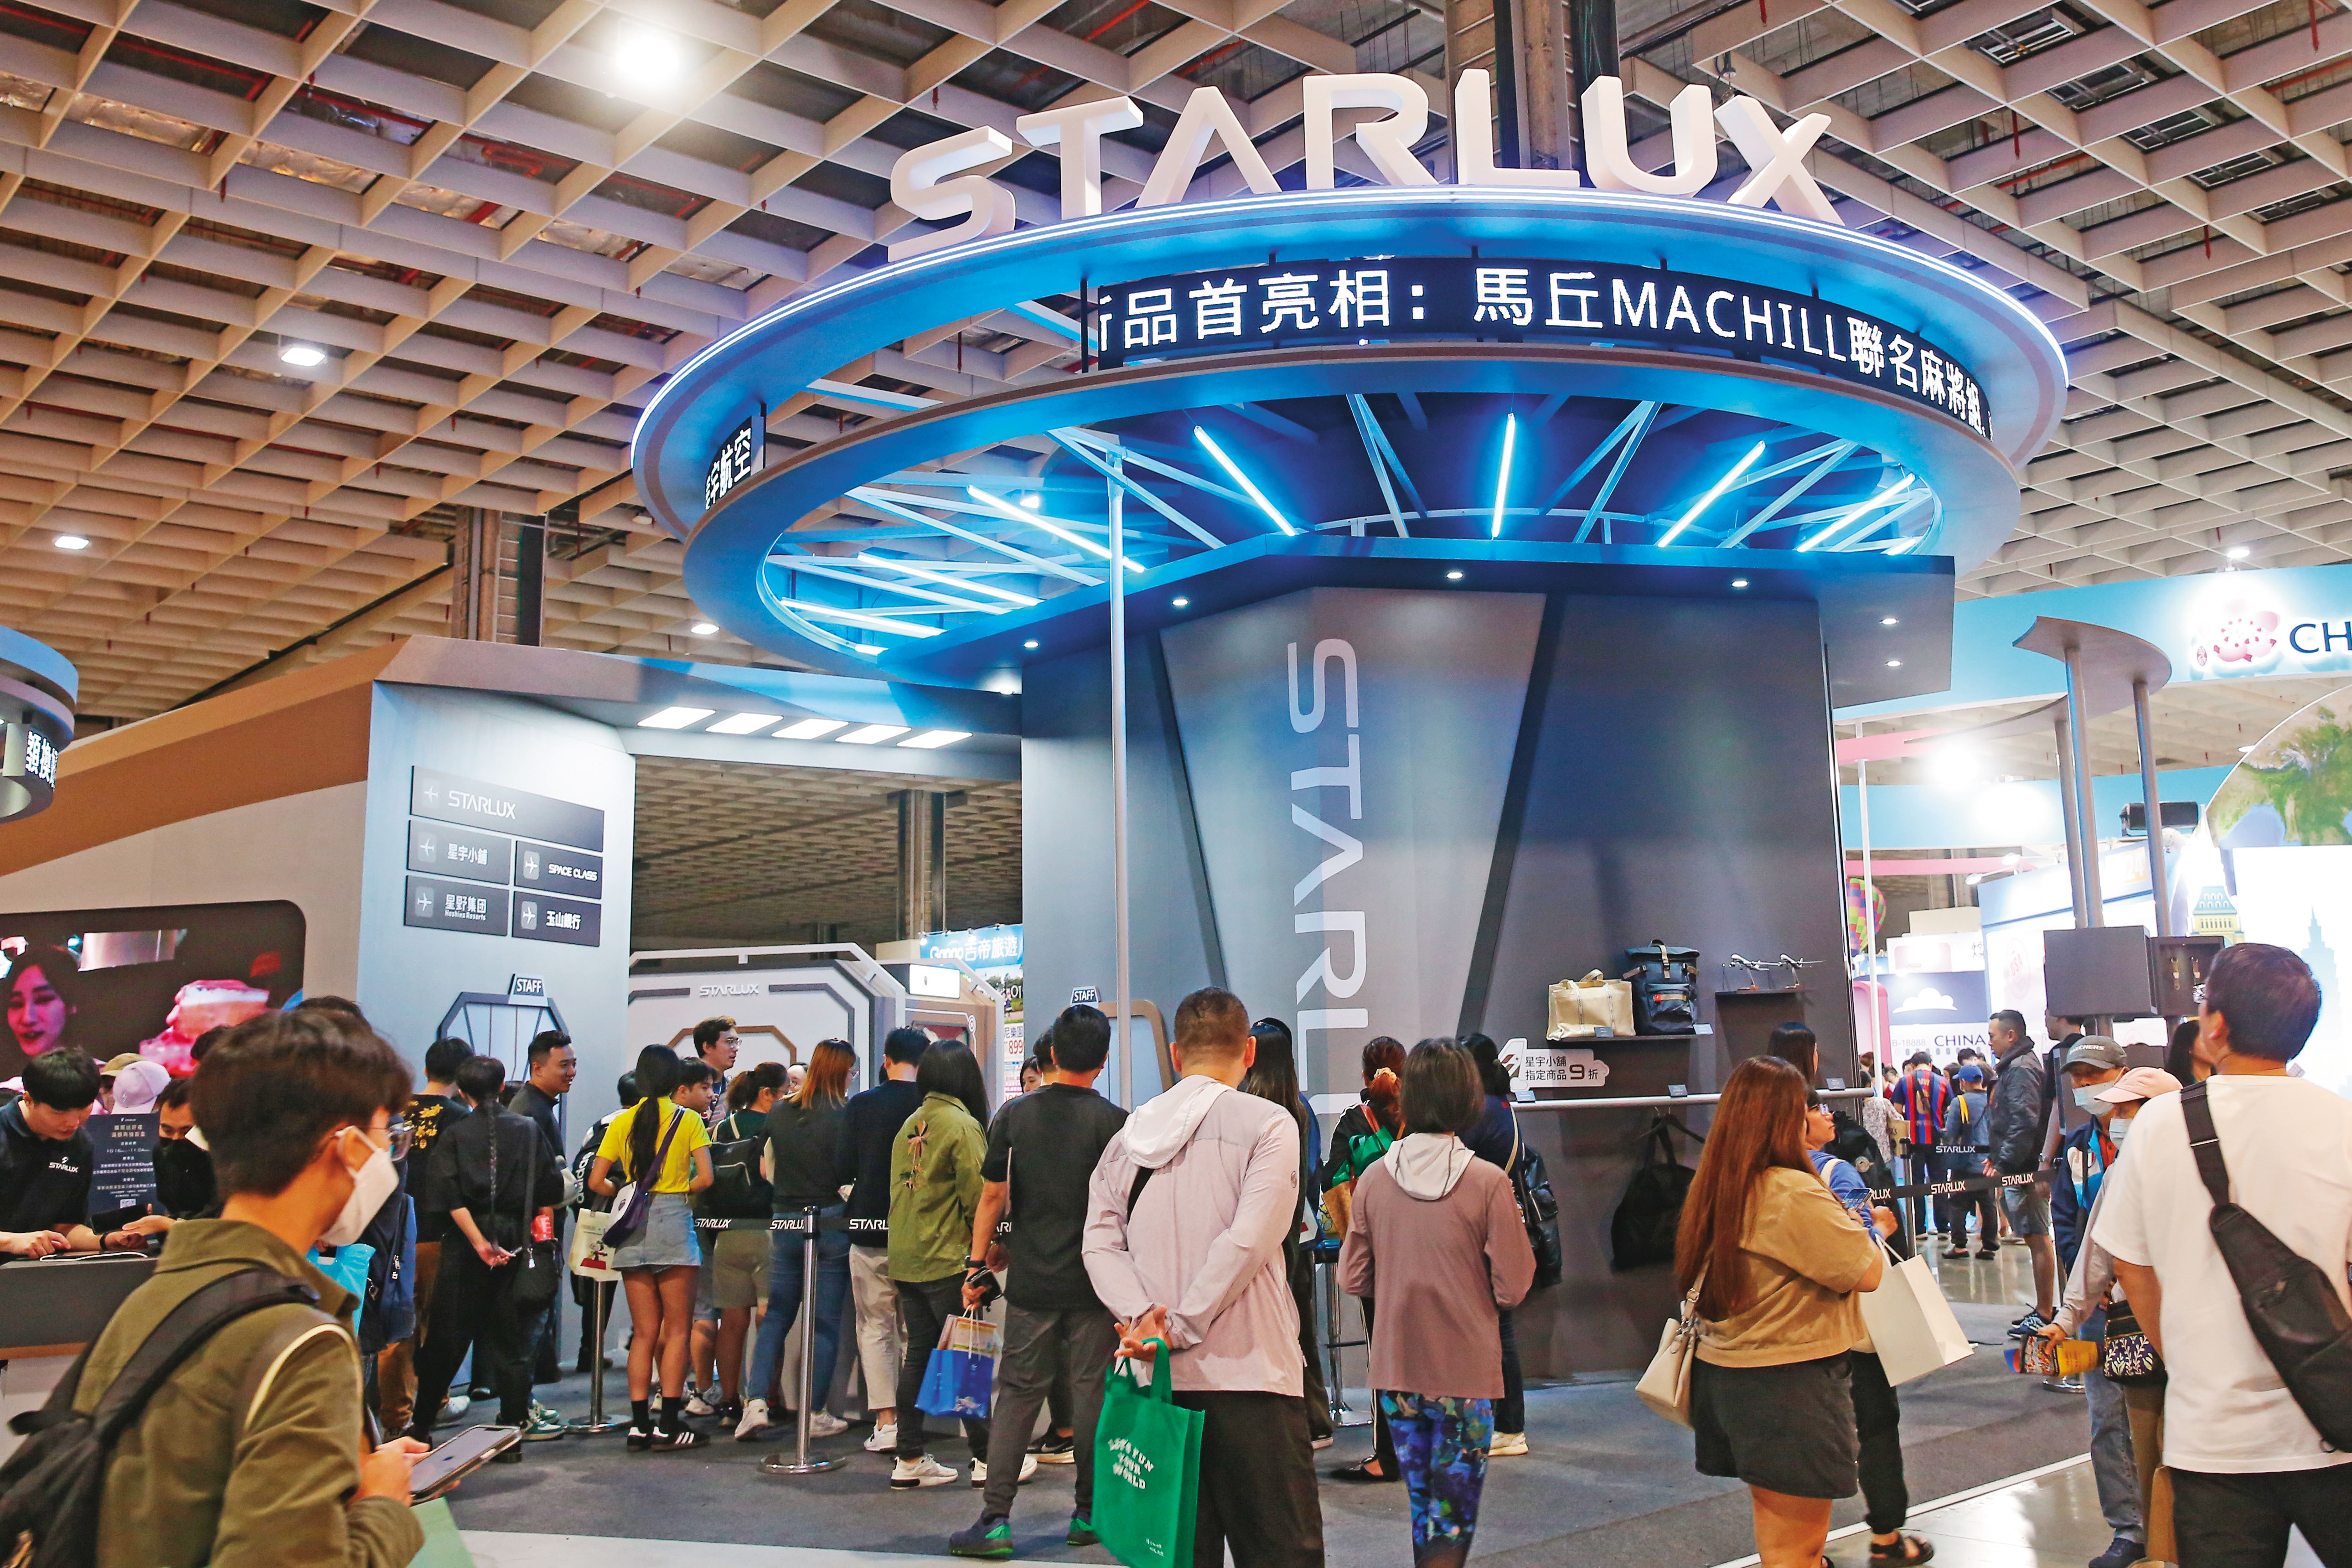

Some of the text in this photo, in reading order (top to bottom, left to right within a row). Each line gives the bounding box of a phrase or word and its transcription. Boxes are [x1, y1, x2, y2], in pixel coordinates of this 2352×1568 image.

[888, 67, 1846, 263] STARLUX
[2289, 621, 2352, 654] CH
[448, 790, 517, 820] STARLUX
[548, 863, 598, 881] SPACE CLASS
[546, 910, 581, 930] 玉山銀行
[964, 935, 1018, 962] 吉帝旅遊
[516, 977, 542, 994] STAFF
[699, 984, 759, 997] STARLUX
[1074, 989, 1095, 1002] STAFF
[1934, 1034, 1986, 1046] CHINA
[1525, 1056, 1566, 1067] 星宇小舖
[1935, 1145, 1976, 1154] STARLUX
[49, 1162, 79, 1173] STARLUX
[2001, 1173, 2034, 1186] STARLUX
[1930, 1181, 1966, 1195] STARLUX
[694, 1218, 732, 1228] STARLUX
[770, 1219, 804, 1230] STARLU
[1132, 1447, 1154, 1472] FUN
[1112, 1462, 1146, 1490] WORLD
